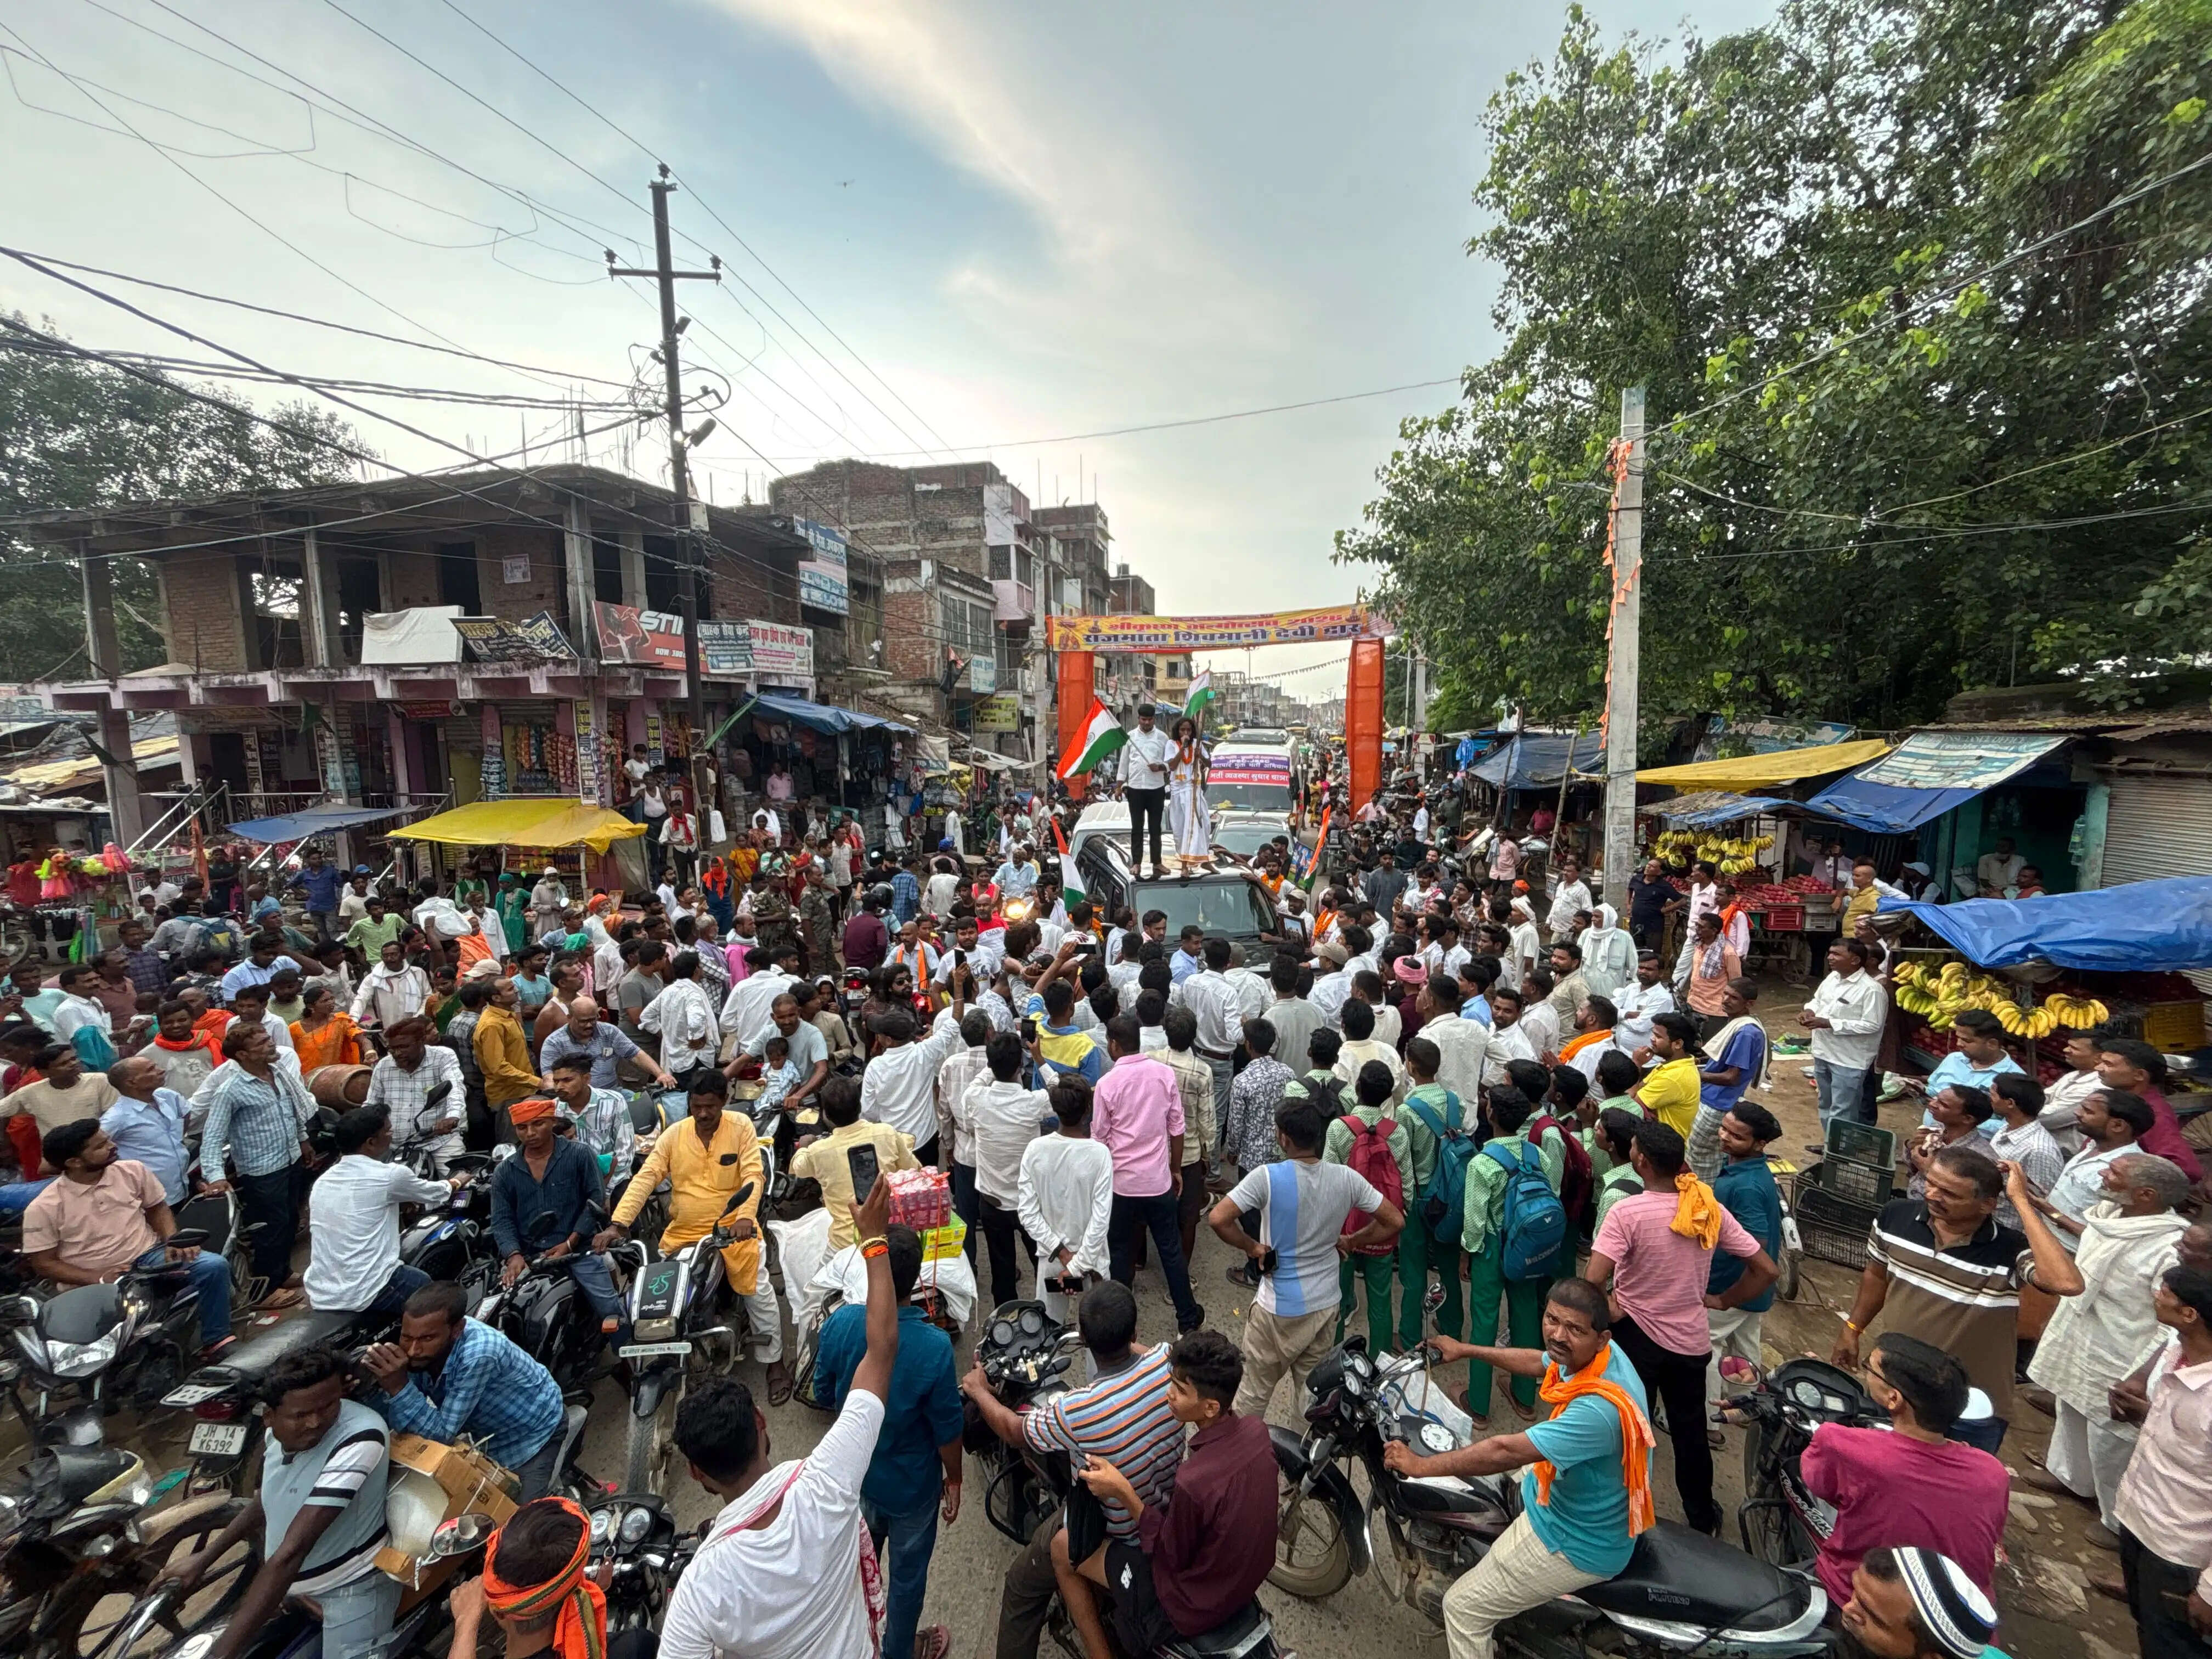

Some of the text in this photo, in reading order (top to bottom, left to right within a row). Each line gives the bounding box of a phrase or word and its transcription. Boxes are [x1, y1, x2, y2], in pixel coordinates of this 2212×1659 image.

[639, 611, 684, 635] STI
[1082, 634, 1171, 645] राजमाता
[1251, 773, 1270, 782] सुधार
[203, 1425, 236, 1440] JH 14
